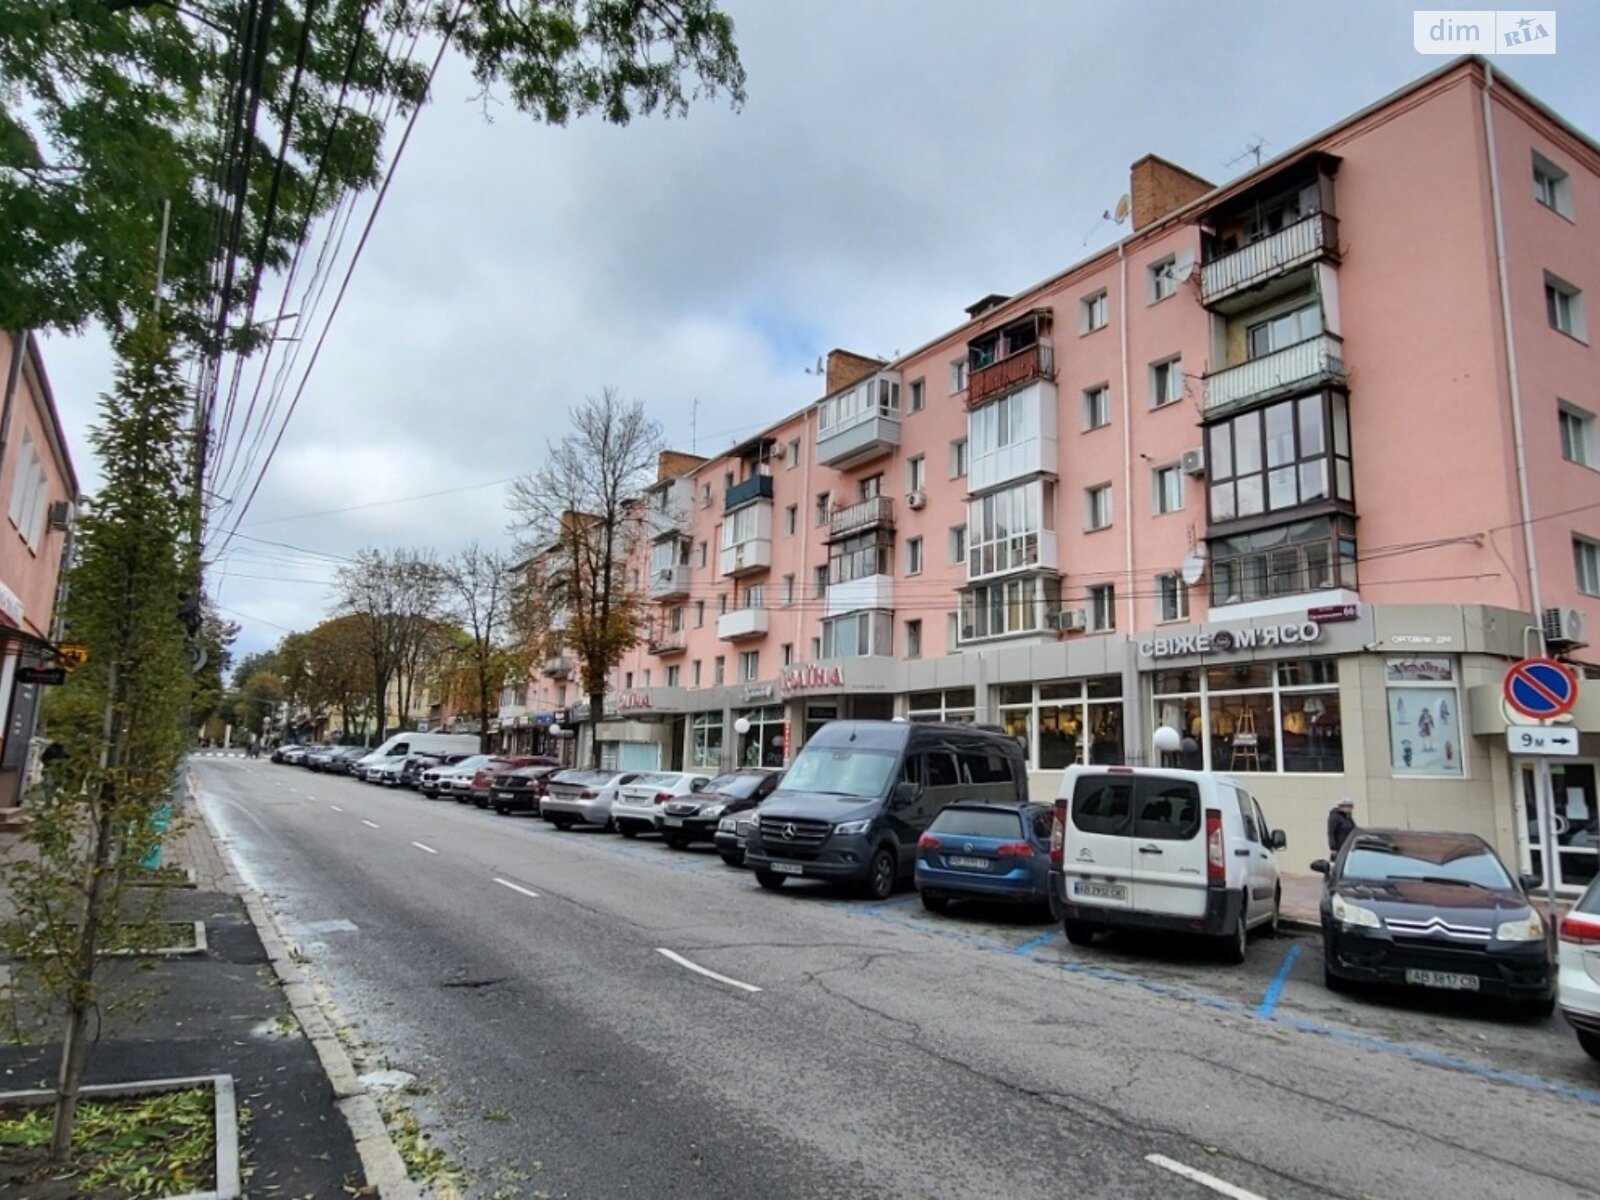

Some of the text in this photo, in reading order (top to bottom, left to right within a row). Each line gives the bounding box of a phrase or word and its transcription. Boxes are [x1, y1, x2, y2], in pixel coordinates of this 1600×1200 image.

[1138, 634, 1210, 657] СВІЖЕ
[1235, 620, 1319, 648] М'ЯСО
[1521, 733, 1533, 747] 9
